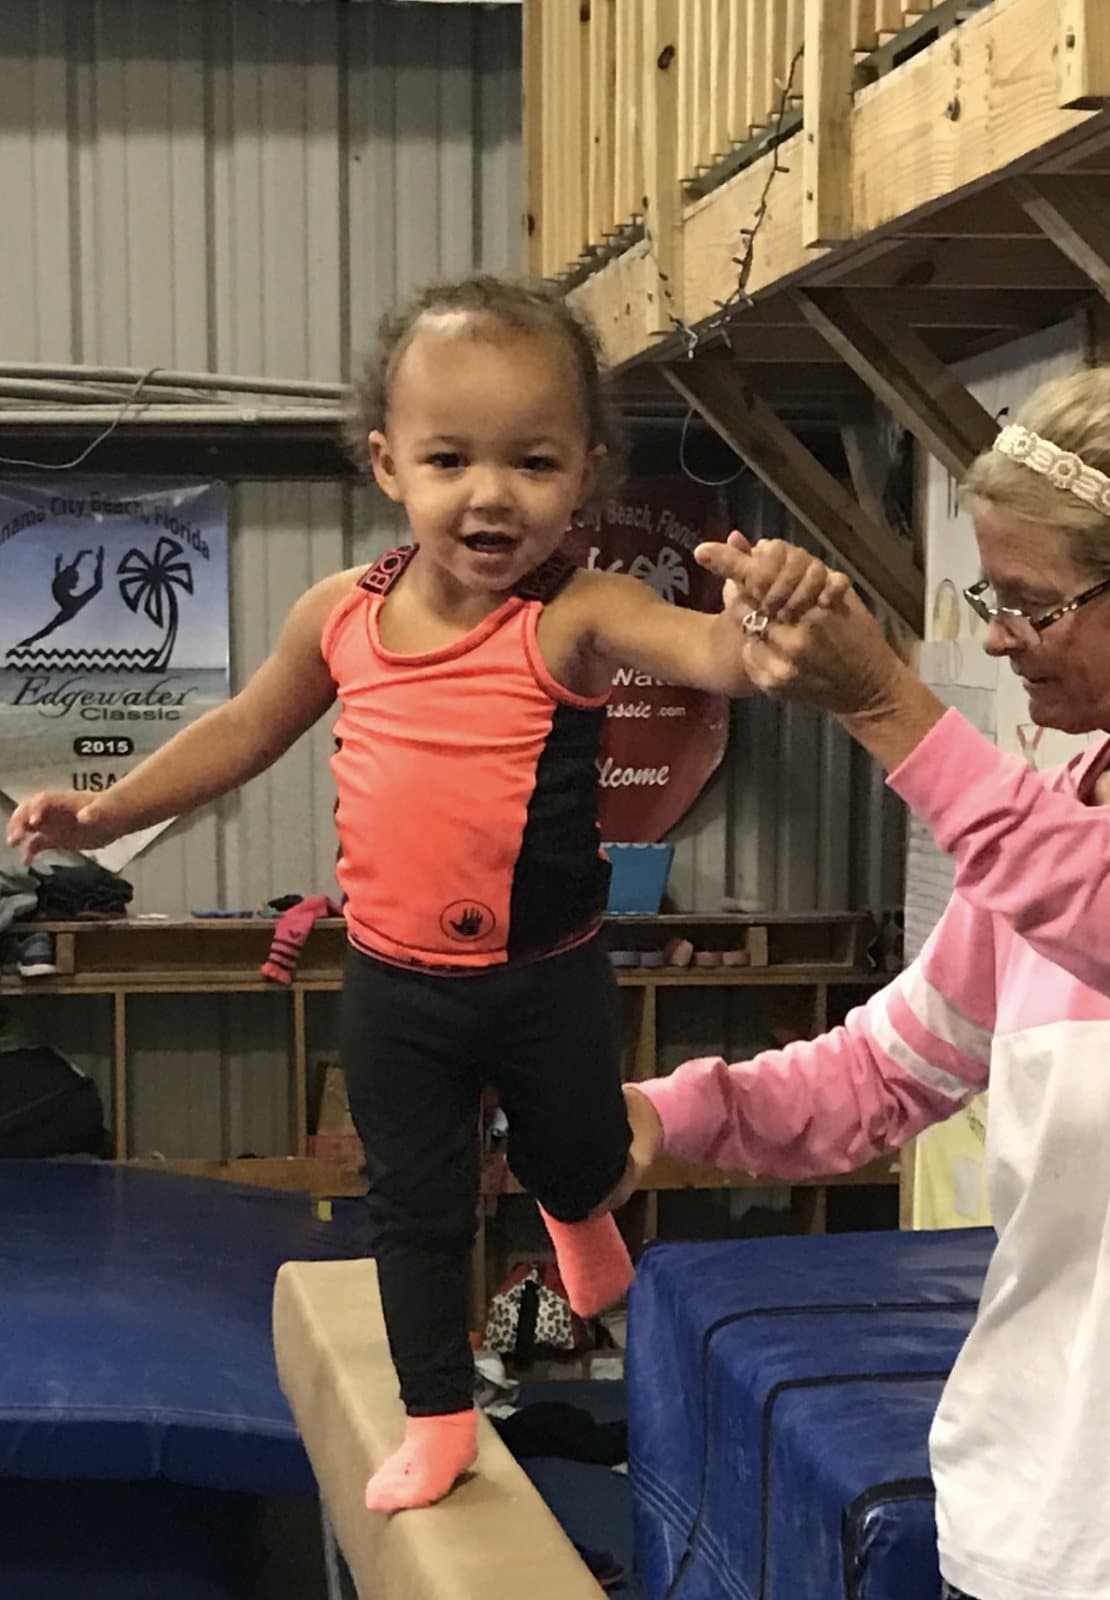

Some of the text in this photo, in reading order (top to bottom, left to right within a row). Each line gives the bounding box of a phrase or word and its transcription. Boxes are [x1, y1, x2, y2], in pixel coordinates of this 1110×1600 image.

[0, 504, 46, 543] nama
[51, 497, 85, 517] City
[154, 506, 210, 560] Florida
[655, 509, 702, 549] Florid
[10, 675, 198, 718] Edgewater
[80, 707, 180, 721] Classic
[80, 740, 129, 754] 2015
[72, 772, 125, 792] USA
[596, 757, 670, 788] lcome
